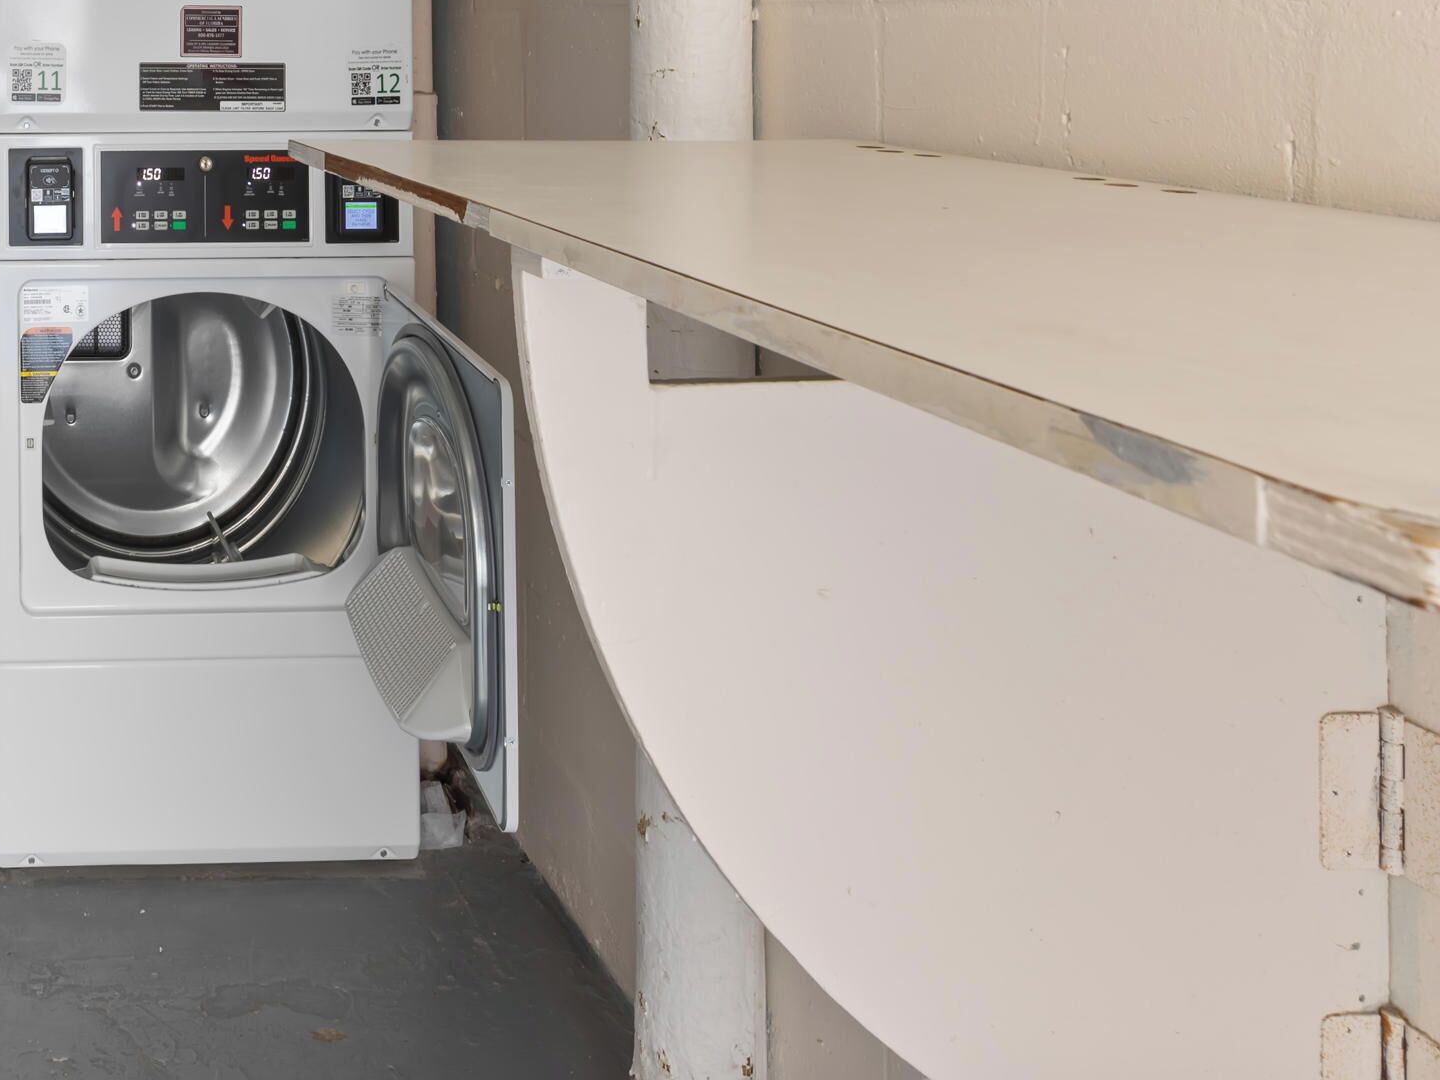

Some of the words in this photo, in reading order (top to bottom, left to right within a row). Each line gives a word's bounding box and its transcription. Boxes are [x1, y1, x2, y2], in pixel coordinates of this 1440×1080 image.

[37, 70, 62, 91] 11
[376, 73, 401, 94] 12
[243, 154, 270, 163] Speed
